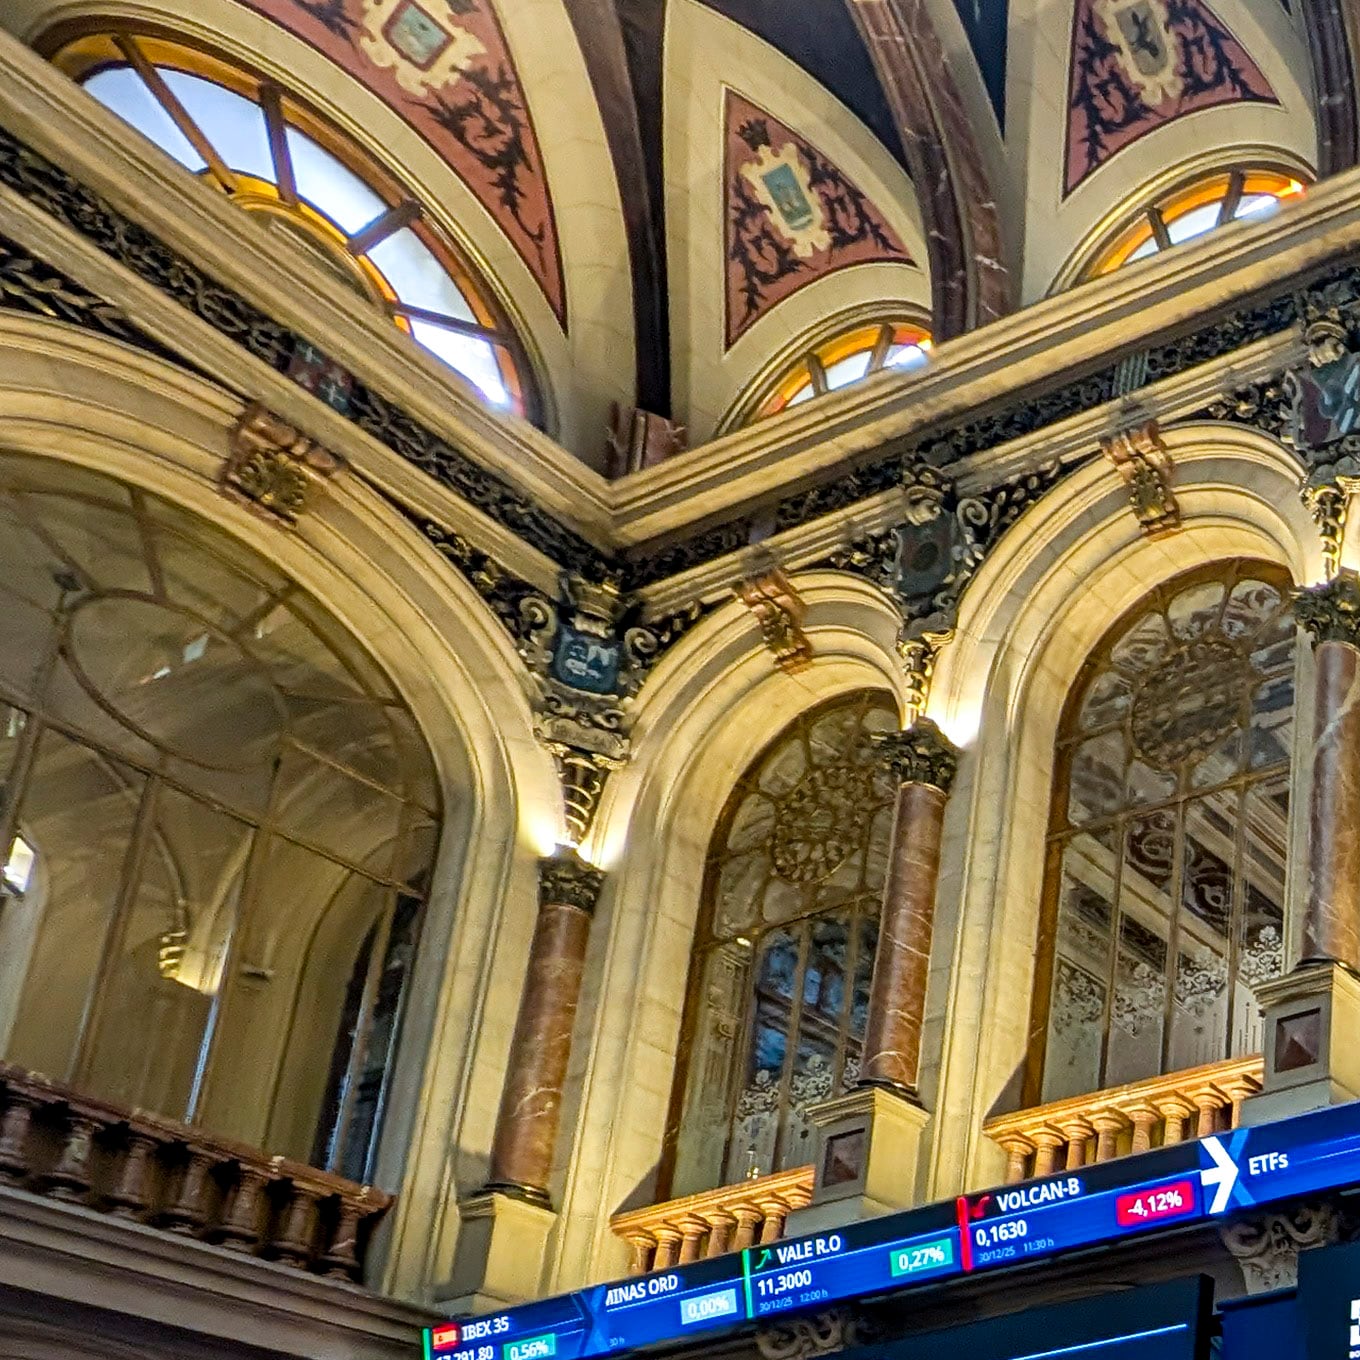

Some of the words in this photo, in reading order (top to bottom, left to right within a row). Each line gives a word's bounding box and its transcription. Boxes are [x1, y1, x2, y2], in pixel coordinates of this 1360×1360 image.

[1248, 1150, 1289, 1177] ETFs
[996, 1177, 1081, 1212] VOLCAN-B
[1127, 1190, 1183, 1218] -4,12%
[976, 1221, 1028, 1247] 0,1630
[777, 1243, 813, 1264] VALE
[816, 1235, 841, 1257] R.O
[895, 1246, 945, 1273] 0,27%
[649, 1275, 678, 1297] ORD
[758, 1270, 812, 1297] 11,3000
[688, 1296, 729, 1318] 0,00%
[461, 1320, 493, 1341] IBEX
[493, 1317, 509, 1335] 35
